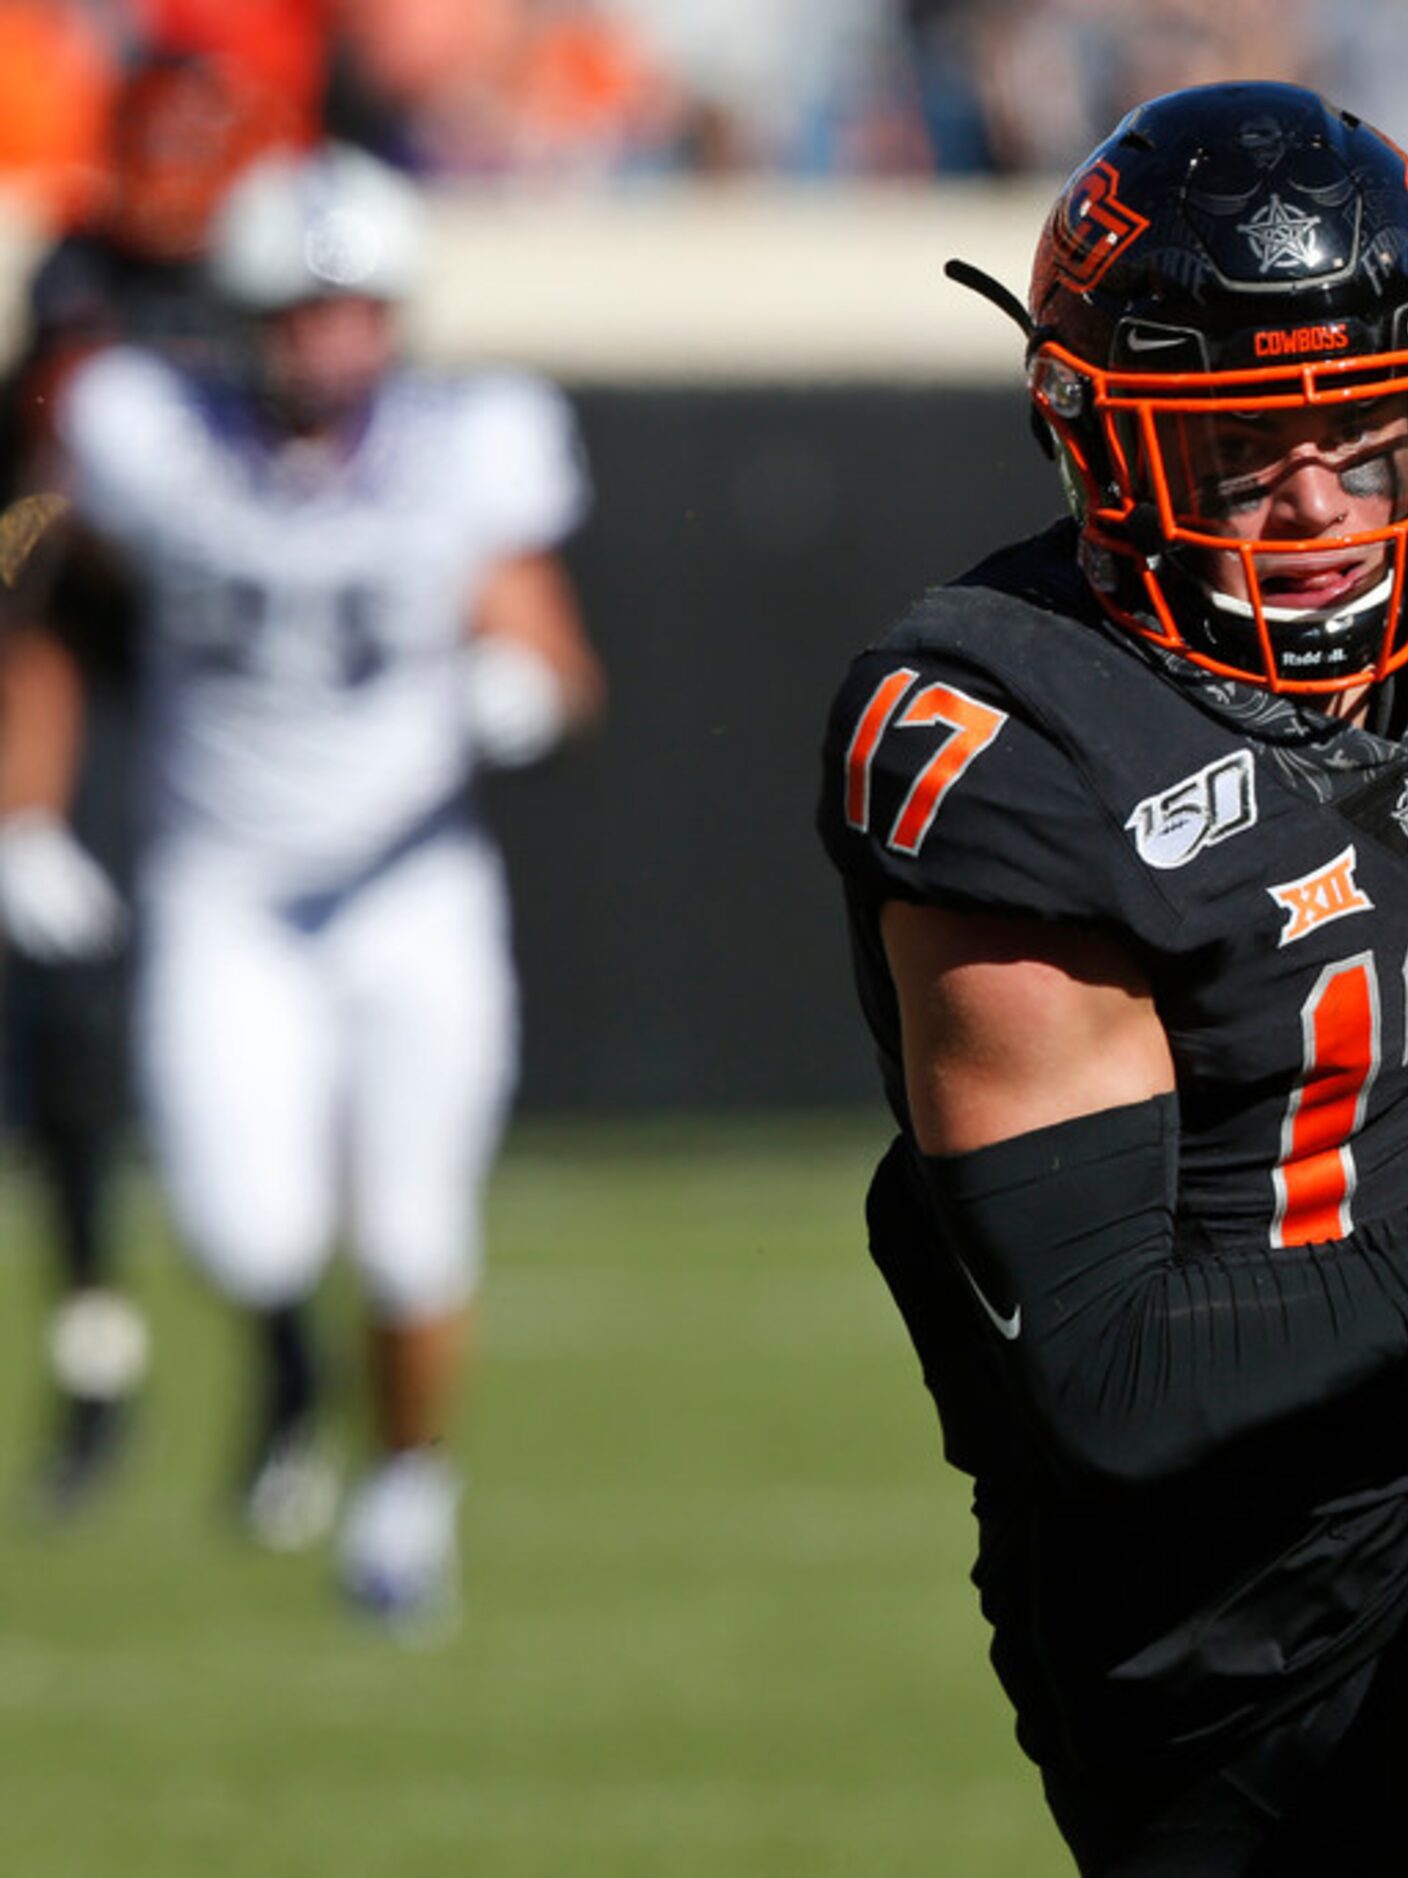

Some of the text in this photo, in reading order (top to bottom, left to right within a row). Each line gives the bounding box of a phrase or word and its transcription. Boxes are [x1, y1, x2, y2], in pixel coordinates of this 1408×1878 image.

[845, 667, 1008, 857] 17
[1126, 749, 1257, 869] 150
[1274, 853, 1369, 943] XII
